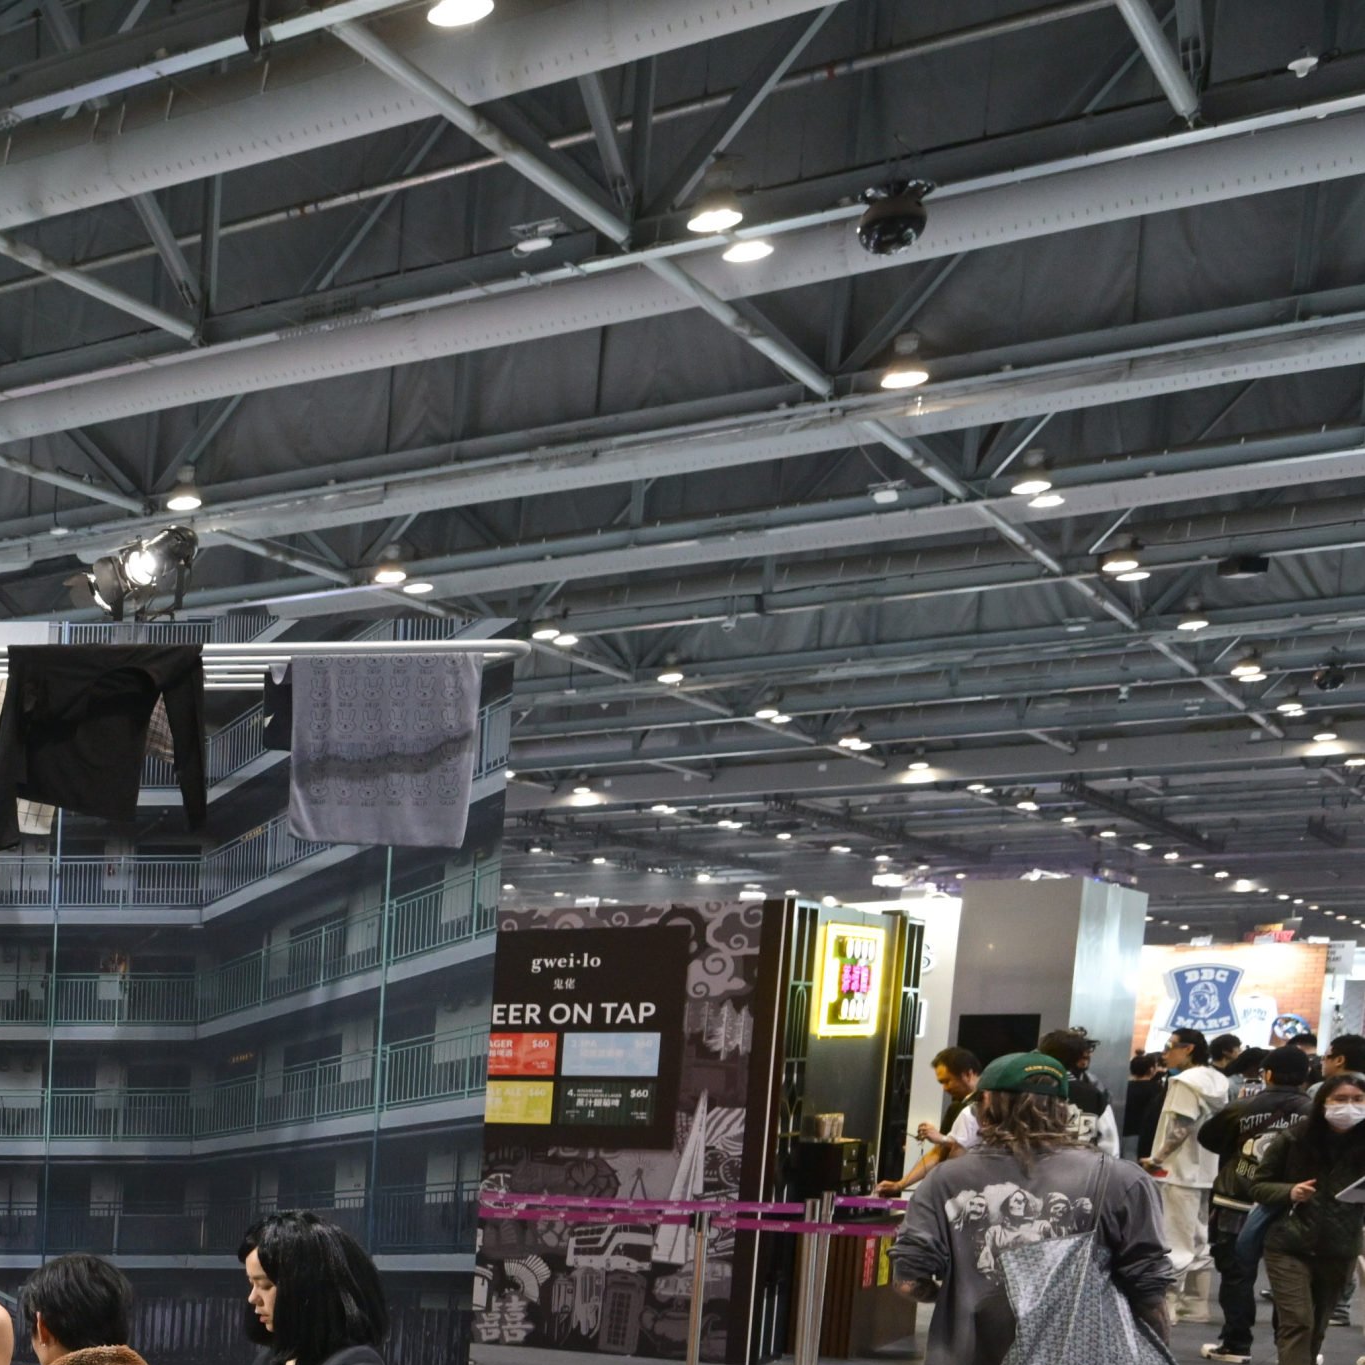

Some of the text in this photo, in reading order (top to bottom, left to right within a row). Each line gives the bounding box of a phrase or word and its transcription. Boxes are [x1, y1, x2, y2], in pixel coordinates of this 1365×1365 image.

[1185, 968, 1229, 983] BBC
[554, 978, 575, 989] 鬼佬
[492, 1003, 655, 1024] EER ON TAP
[1176, 1016, 1232, 1030] MART
[489, 1039, 549, 1048] AGER $60
[630, 1089, 648, 1098] $60
